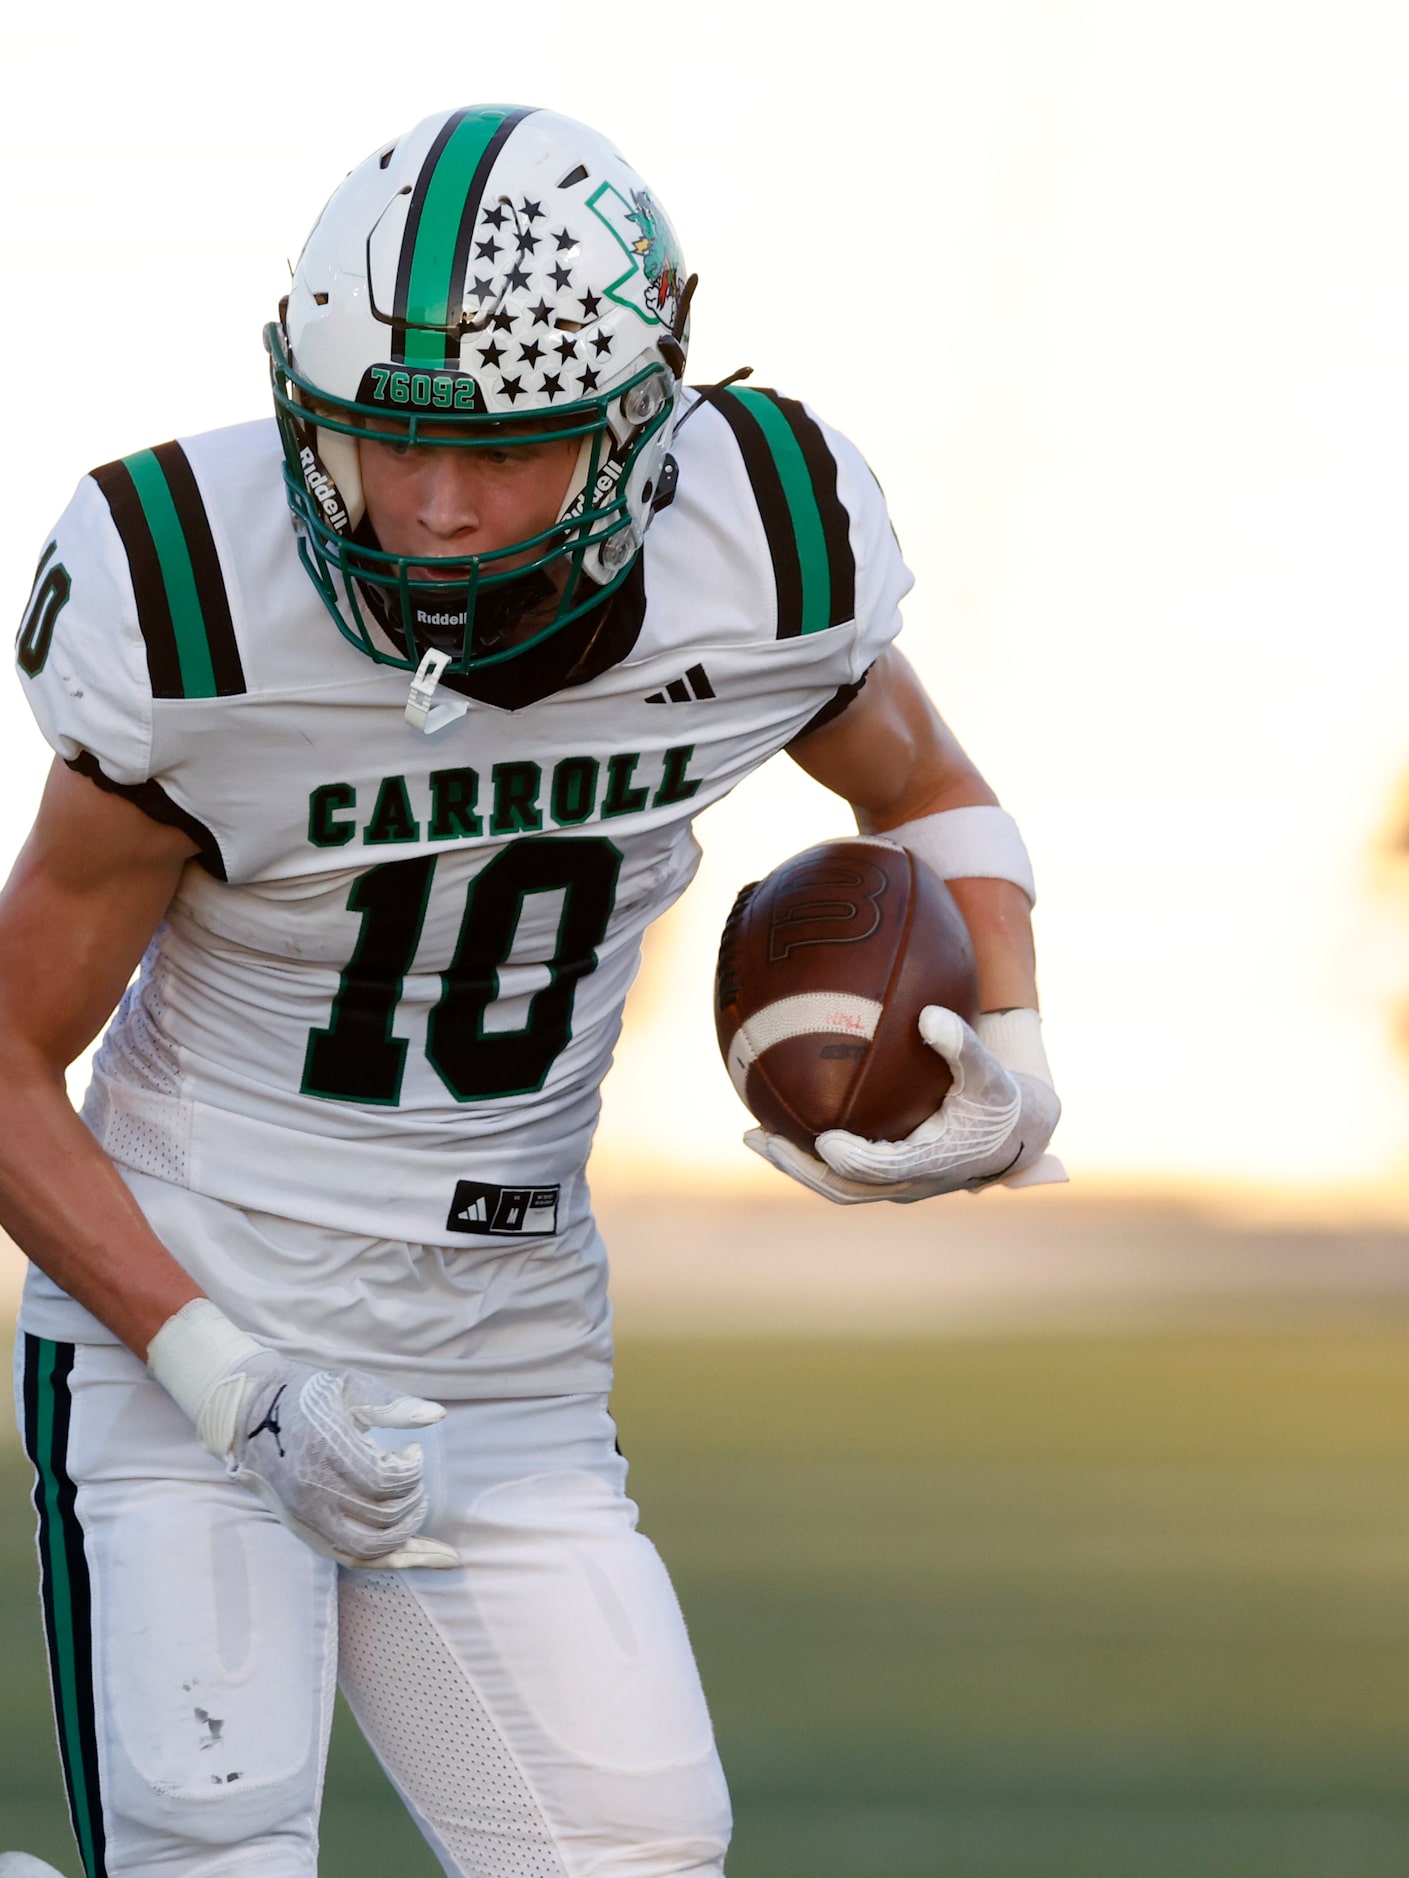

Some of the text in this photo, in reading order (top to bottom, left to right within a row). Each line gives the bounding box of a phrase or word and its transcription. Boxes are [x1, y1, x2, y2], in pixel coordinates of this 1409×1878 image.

[371, 368, 475, 409] 76092
[300, 446, 347, 530] Riddell
[417, 610, 468, 626] Riddell
[308, 744, 703, 848] CARROLL
[300, 836, 624, 1107] 10
